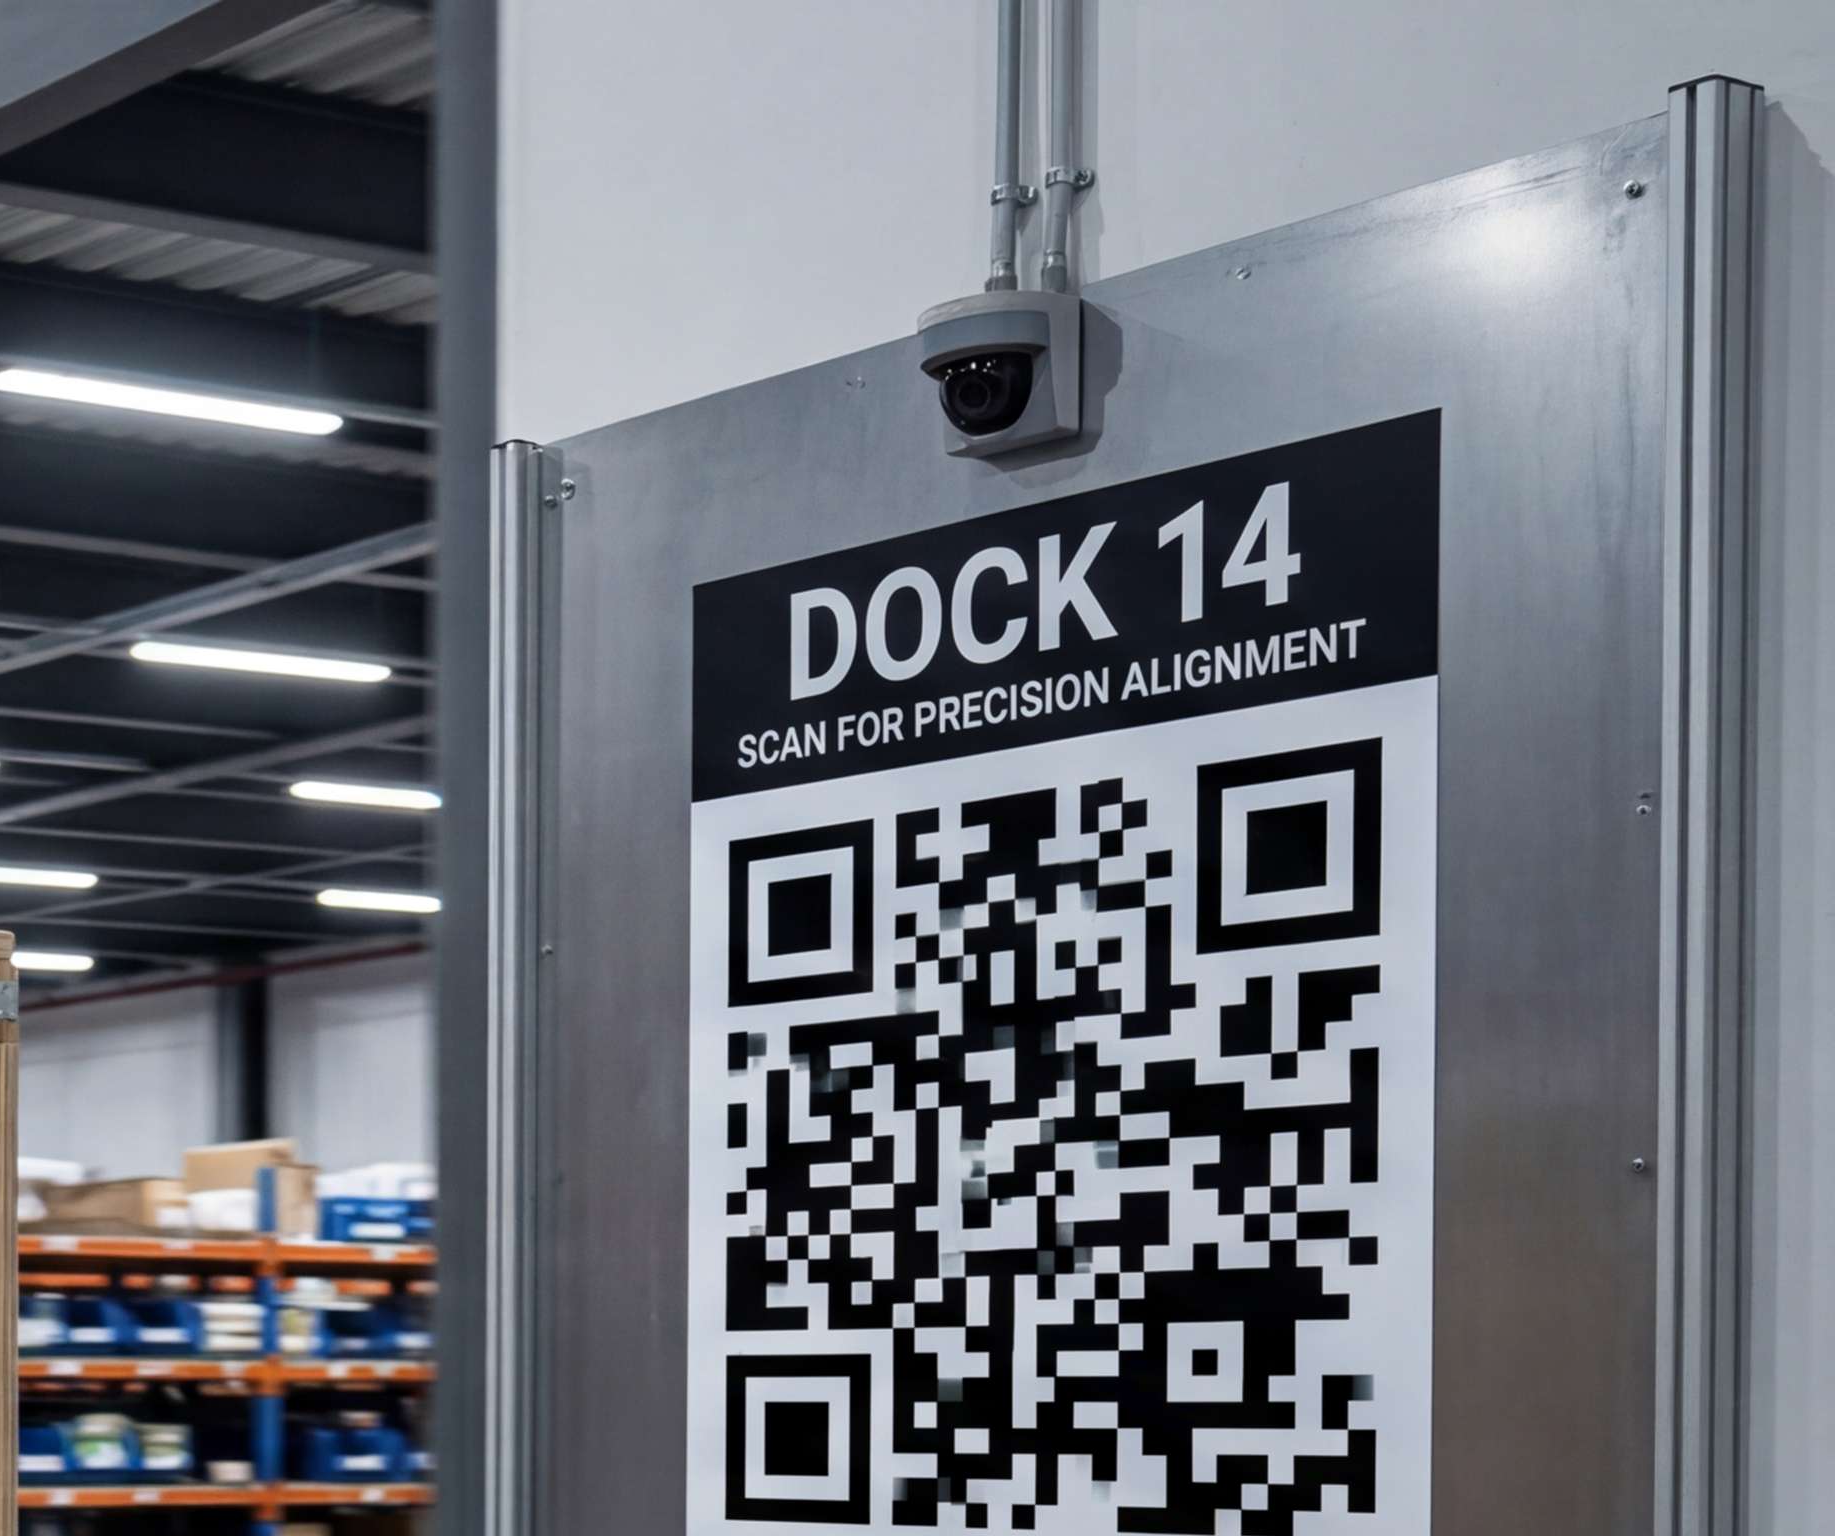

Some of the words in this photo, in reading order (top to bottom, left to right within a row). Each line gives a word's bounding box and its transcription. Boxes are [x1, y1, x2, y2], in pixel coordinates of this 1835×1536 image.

[790, 521, 1118, 700] DOCK
[1157, 481, 1301, 623] 14
[737, 721, 827, 769] SCAN
[837, 707, 904, 750] FOR
[915, 667, 1110, 738] PRECISION
[1120, 618, 1367, 700] ALIGNMENT
